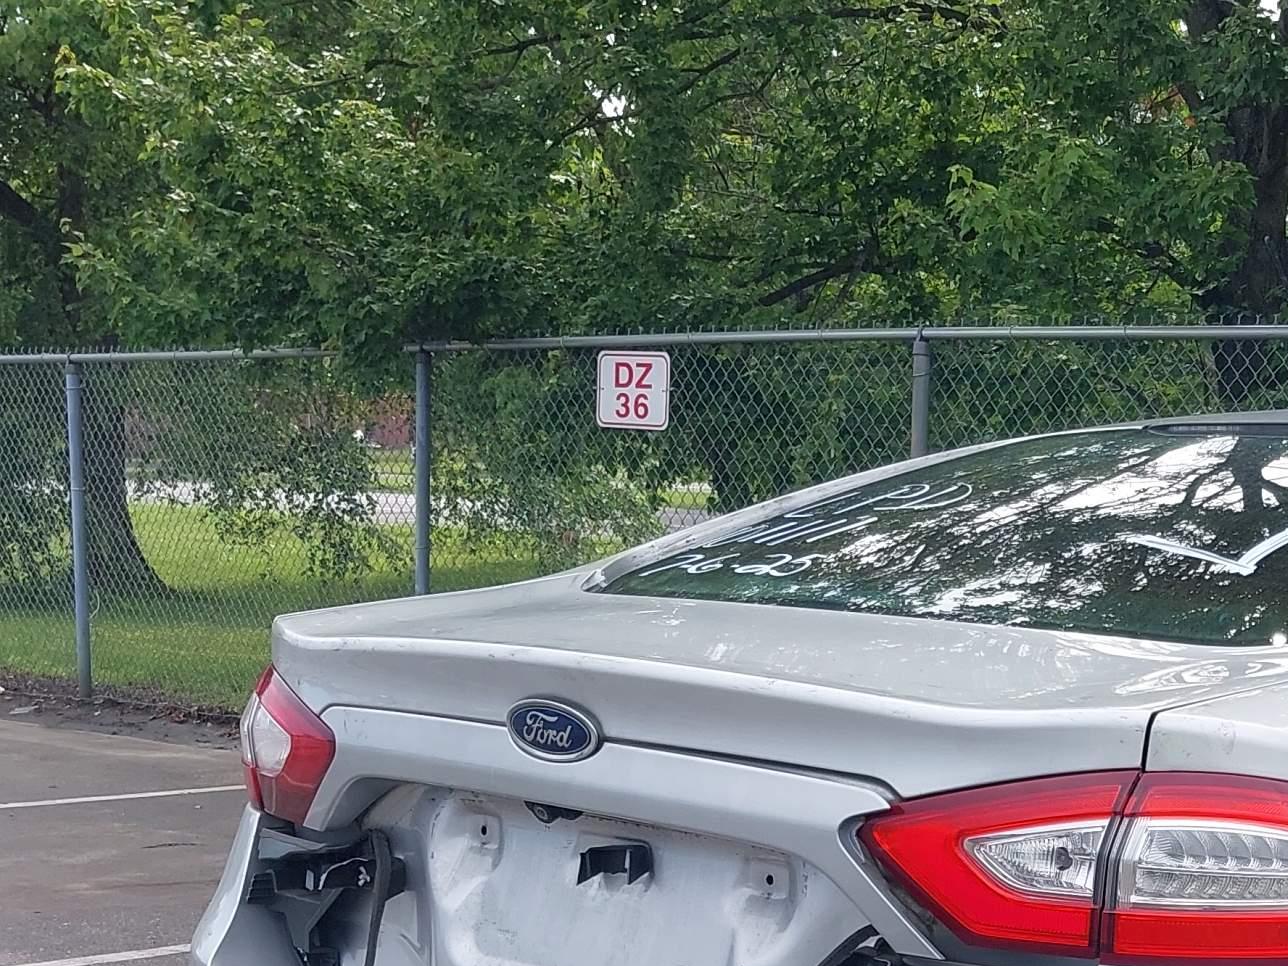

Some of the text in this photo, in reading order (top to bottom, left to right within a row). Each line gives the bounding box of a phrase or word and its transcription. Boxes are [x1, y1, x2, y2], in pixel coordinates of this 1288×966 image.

[614, 362, 653, 389] DZ
[615, 393, 649, 419] 36
[523, 711, 572, 748] Ford
